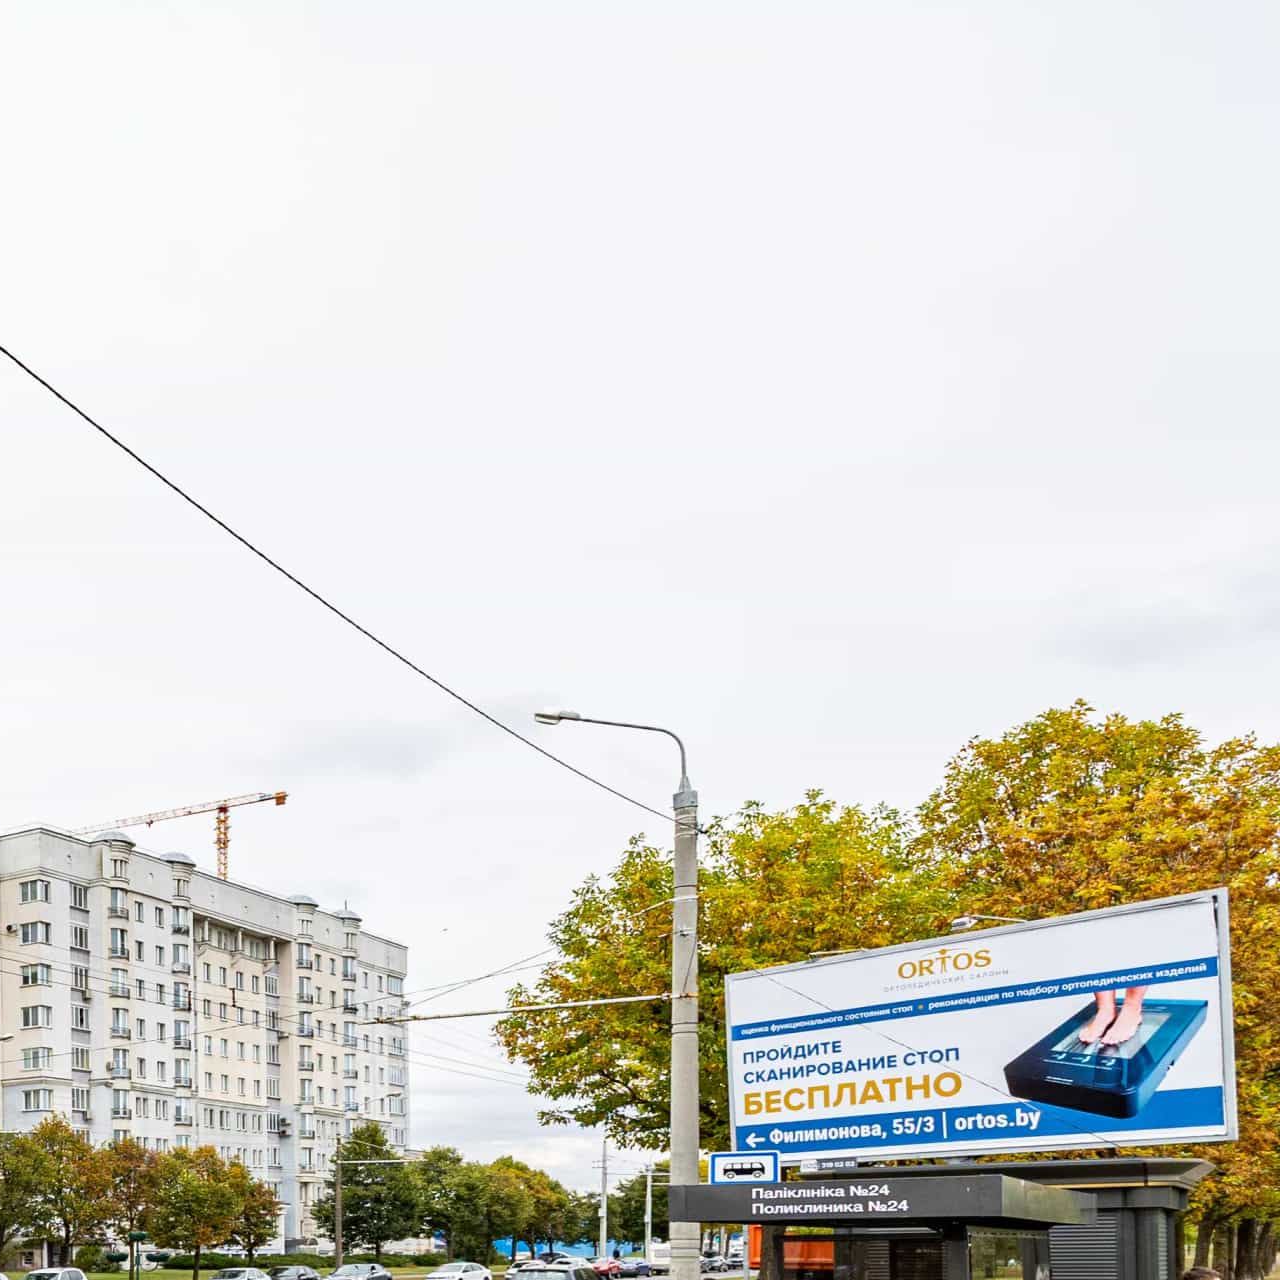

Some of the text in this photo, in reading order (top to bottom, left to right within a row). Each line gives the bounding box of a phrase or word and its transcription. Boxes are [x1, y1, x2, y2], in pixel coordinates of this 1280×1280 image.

[897, 949, 992, 979] ORTOS
[741, 962, 1207, 1036] оценка функционального состояния стоп рекомендация по подбору ортопедических изделий
[743, 1040, 842, 1065] ПРОЙДИТЕ
[743, 1047, 960, 1084] СКАНИРОВАНИЕ СТОП
[743, 1071, 963, 1116] БЕСПЛАТНО
[769, 1116, 935, 1144] Филимонова, 55/3
[954, 1108, 1041, 1132] ortos.by
[751, 1184, 890, 1199] Паліклініка №24
[752, 1199, 909, 1215] Поликлиника №24
